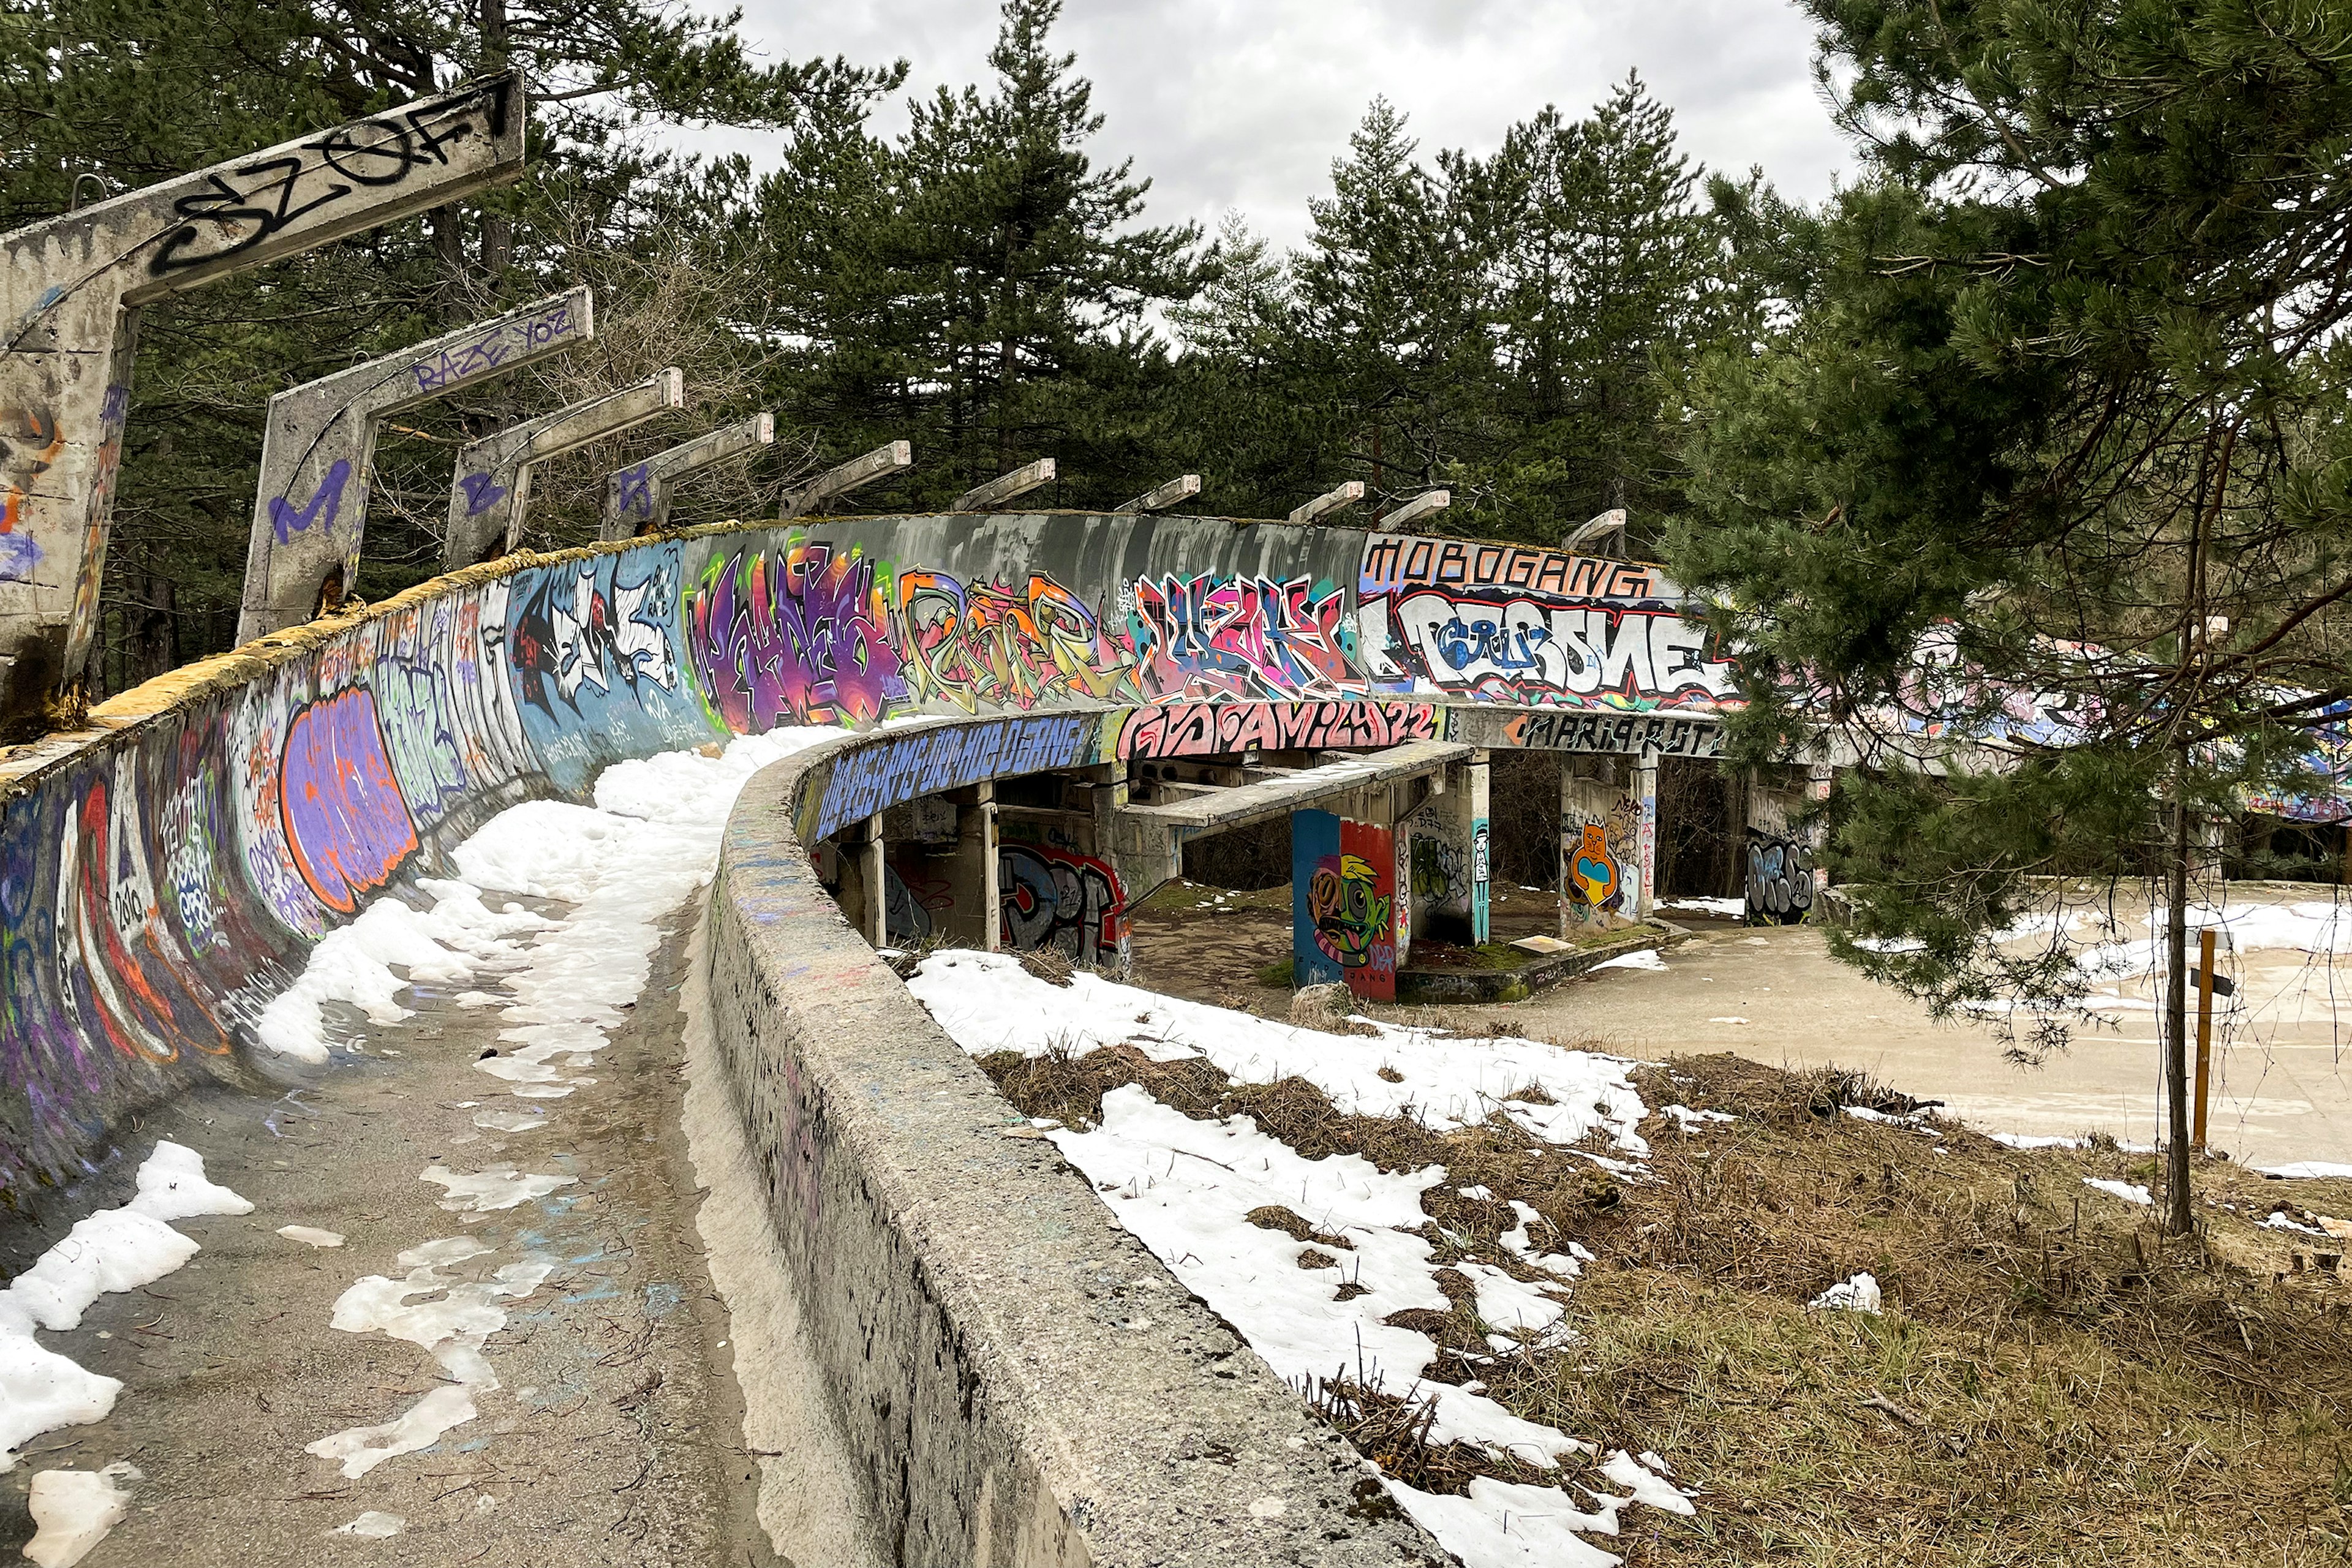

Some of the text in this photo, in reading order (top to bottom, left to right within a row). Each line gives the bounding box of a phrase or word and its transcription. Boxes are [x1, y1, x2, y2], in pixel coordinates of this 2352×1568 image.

[412, 330, 512, 393] RAZE
[268, 459, 351, 545] M
[648, 582, 672, 601] MARK
[1365, 538, 1654, 599] HOBOGANG
